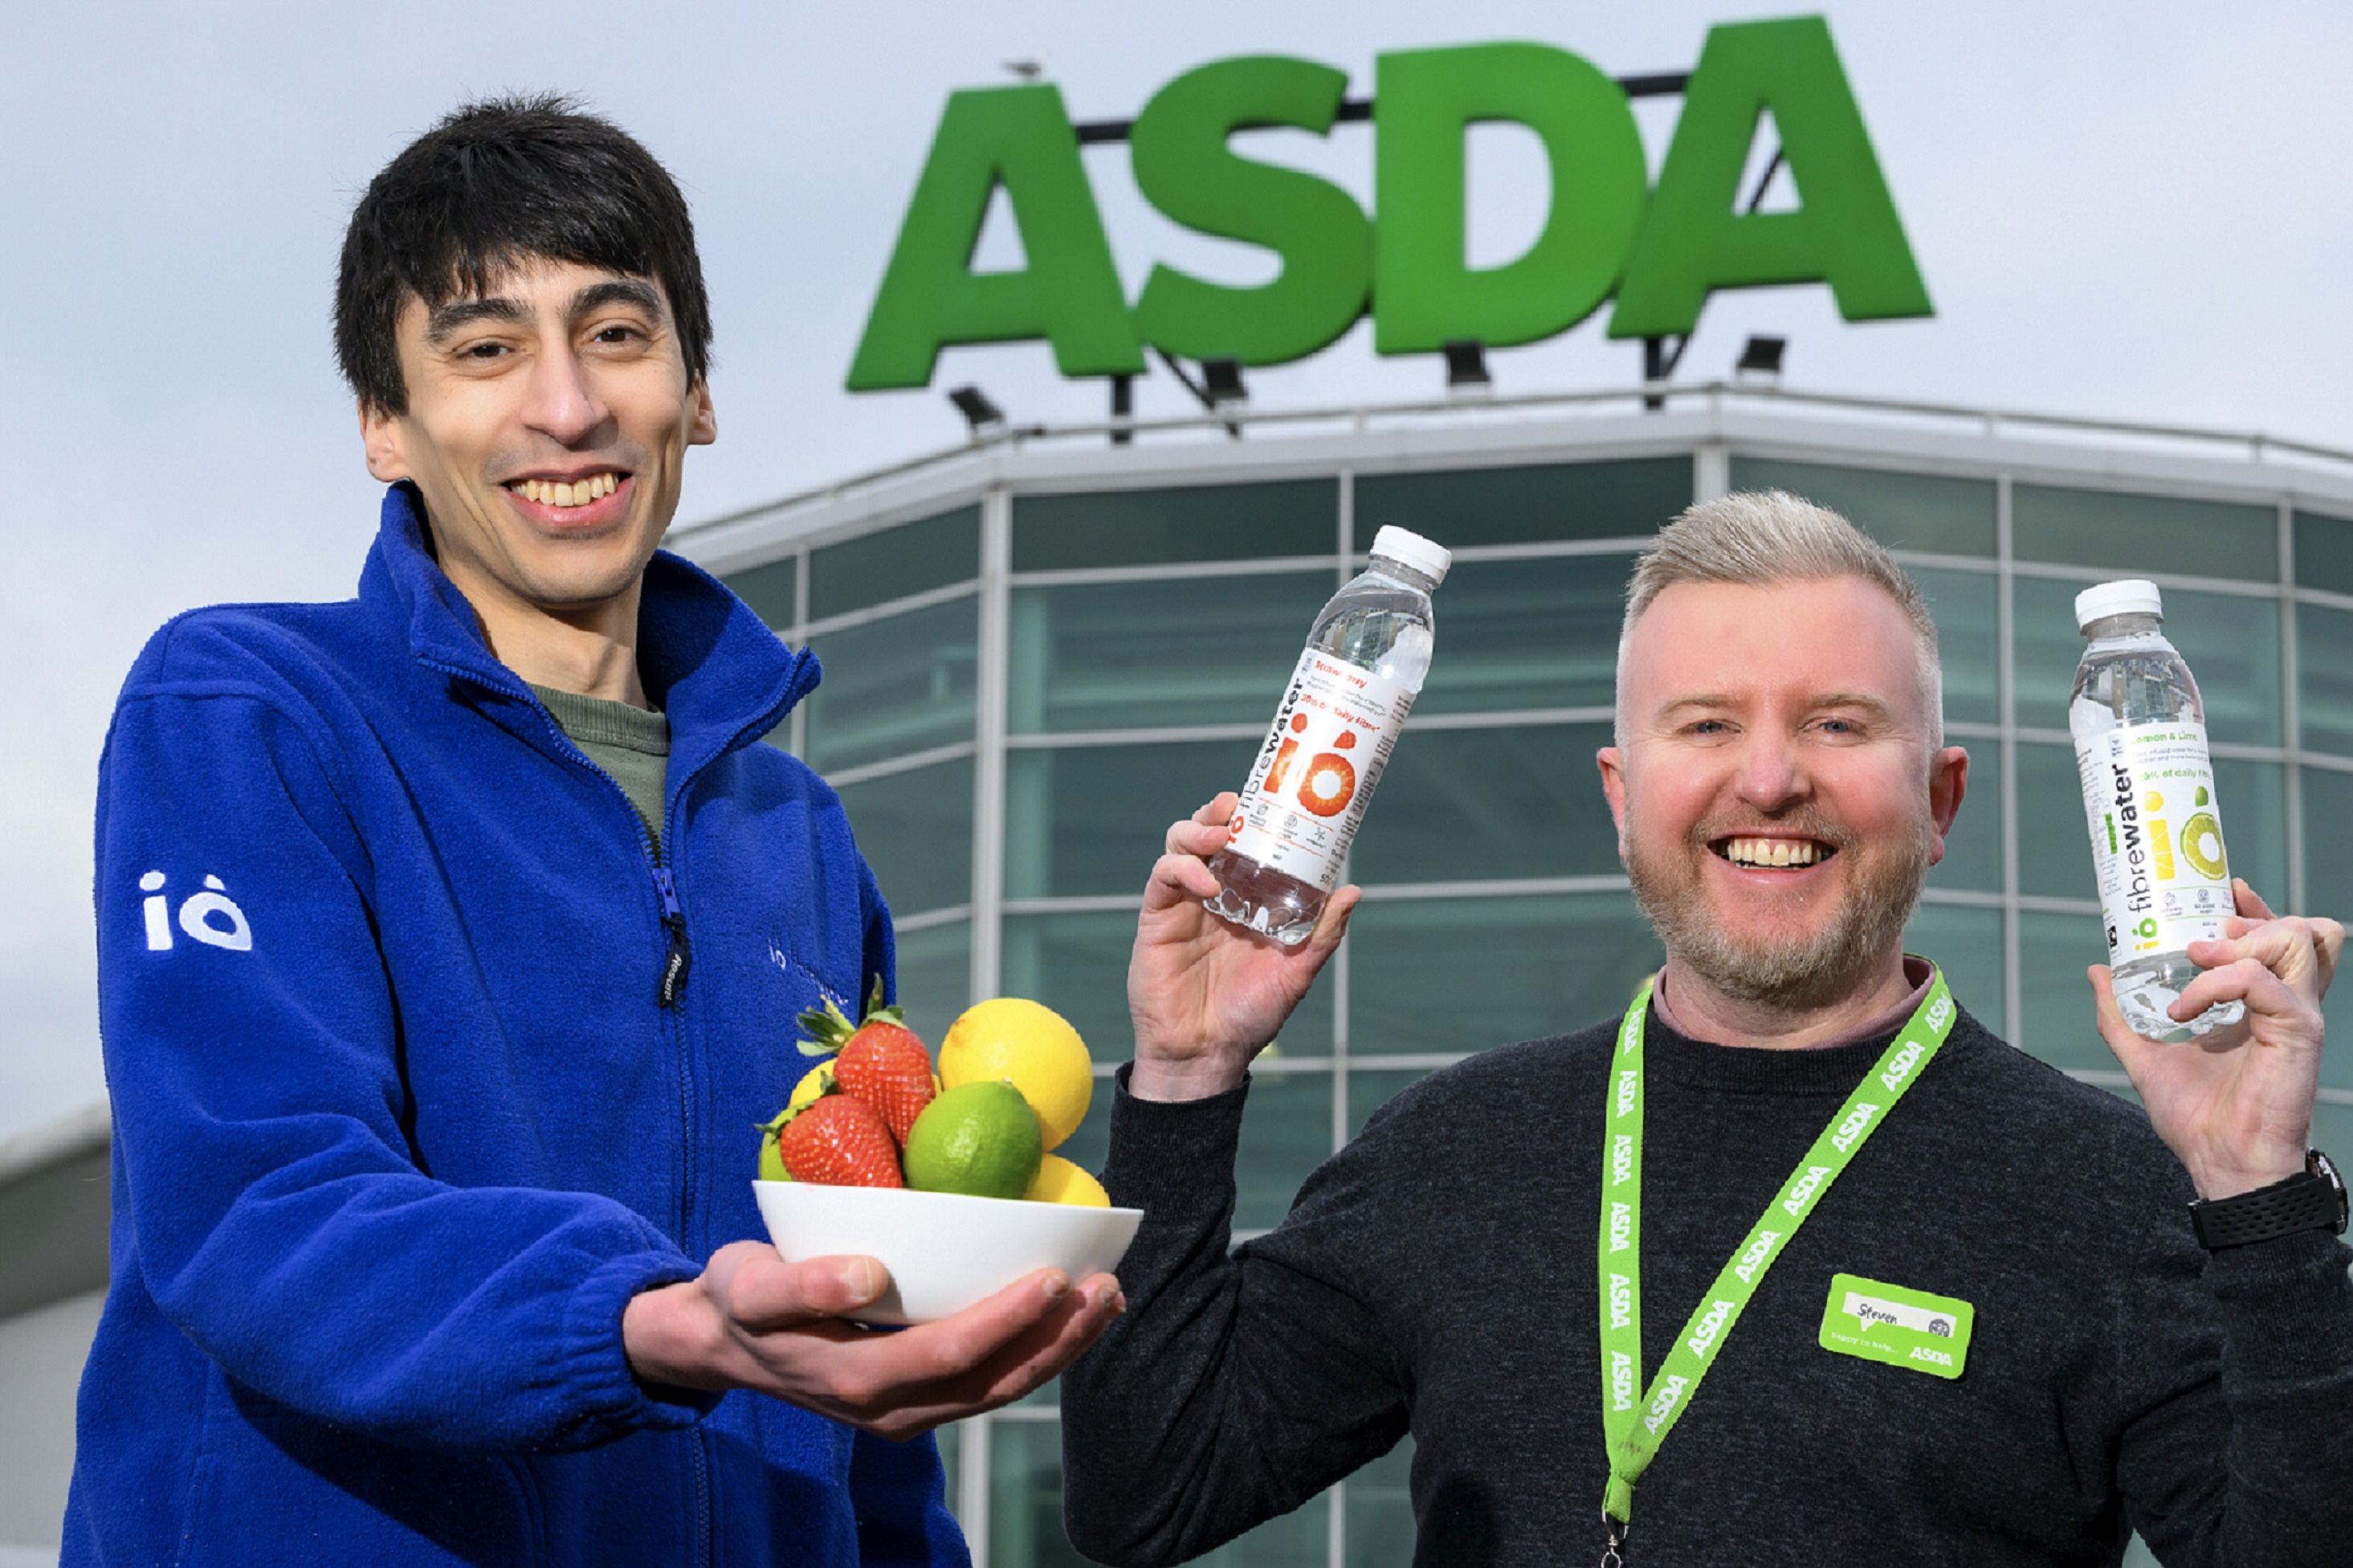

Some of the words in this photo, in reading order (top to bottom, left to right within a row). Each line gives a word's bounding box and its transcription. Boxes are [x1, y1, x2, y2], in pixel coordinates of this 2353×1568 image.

[844, 11, 1938, 393] ASDA
[1240, 678, 1303, 809] fibrewater
[2132, 731, 2167, 745] emon
[2111, 764, 2152, 914] fibrewater
[1624, 1007, 1644, 1056] ASDA
[1924, 990, 1953, 1034] ASDA
[1879, 1041, 1927, 1092] ASDA
[1616, 1069, 1637, 1119] ASDA
[1831, 1102, 1880, 1153] ASDA
[1612, 1134, 1633, 1187] ASDA
[1782, 1165, 1832, 1216] ASDA
[1609, 1201, 1631, 1254] ASDA
[1734, 1229, 1782, 1284] ASDA
[1609, 1272, 1631, 1330] ASDA
[1857, 1302, 1898, 1325] Steven
[1687, 1299, 1735, 1358] ASDA
[1831, 1330, 1858, 1346] happy
[1860, 1337, 1870, 1348] to
[1611, 1350, 1632, 1411] ASDA
[1909, 1346, 1953, 1367] ASDA
[1643, 1374, 1688, 1435] ASDA
